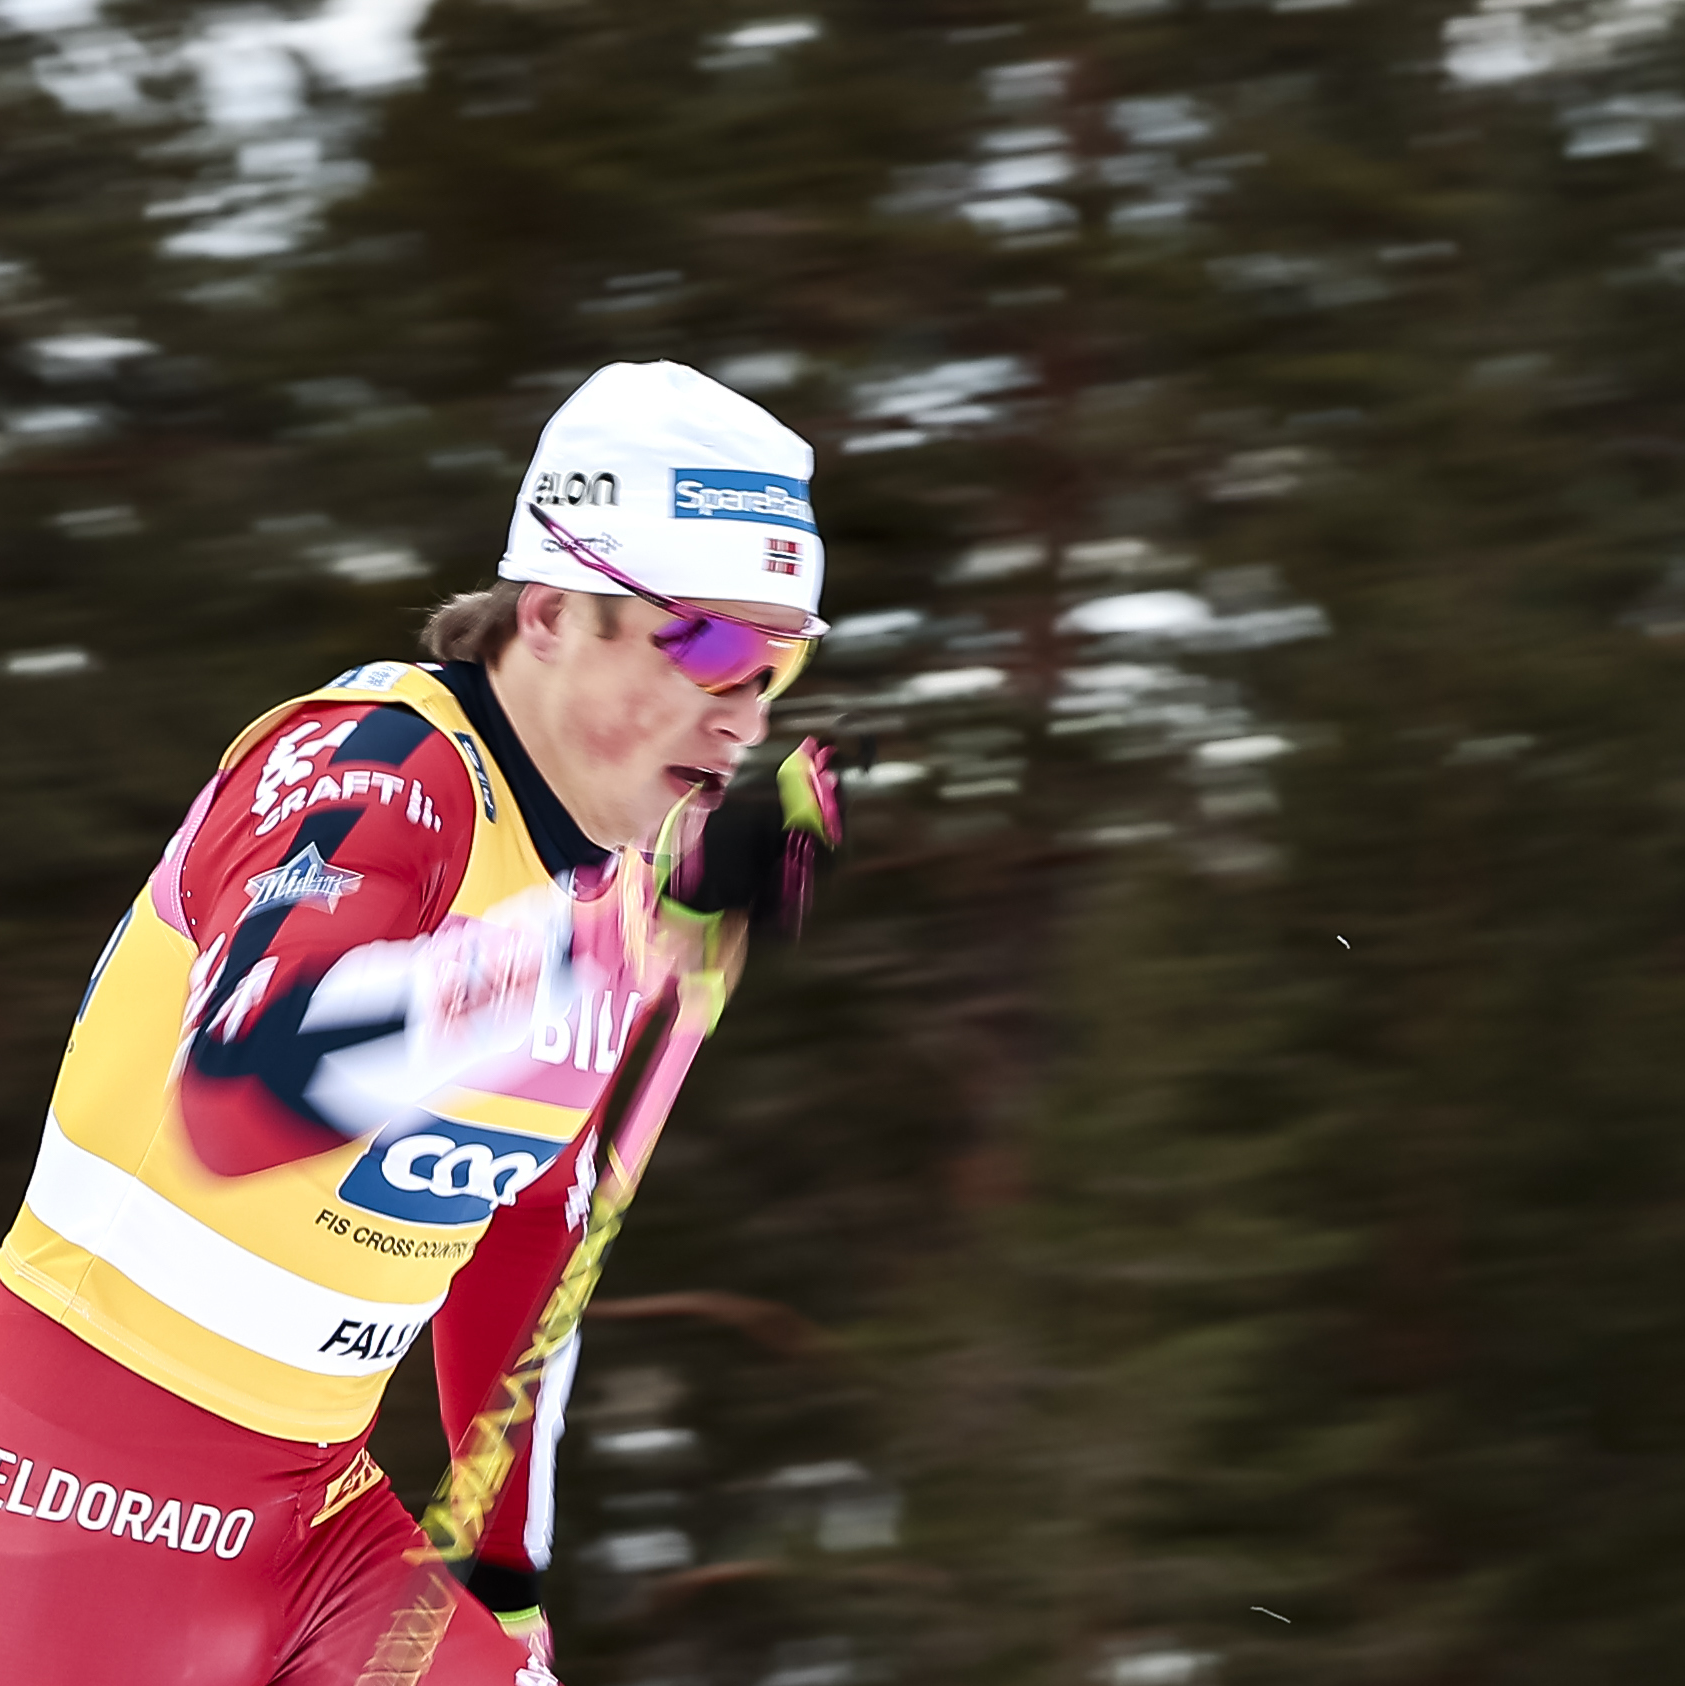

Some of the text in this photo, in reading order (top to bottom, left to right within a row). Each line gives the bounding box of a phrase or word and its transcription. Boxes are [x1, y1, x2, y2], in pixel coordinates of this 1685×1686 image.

[255, 771, 405, 837] CRAFT
[315, 1208, 351, 1235] FIS
[353, 1227, 415, 1258] CROSS
[317, 1318, 428, 1360] FALU
